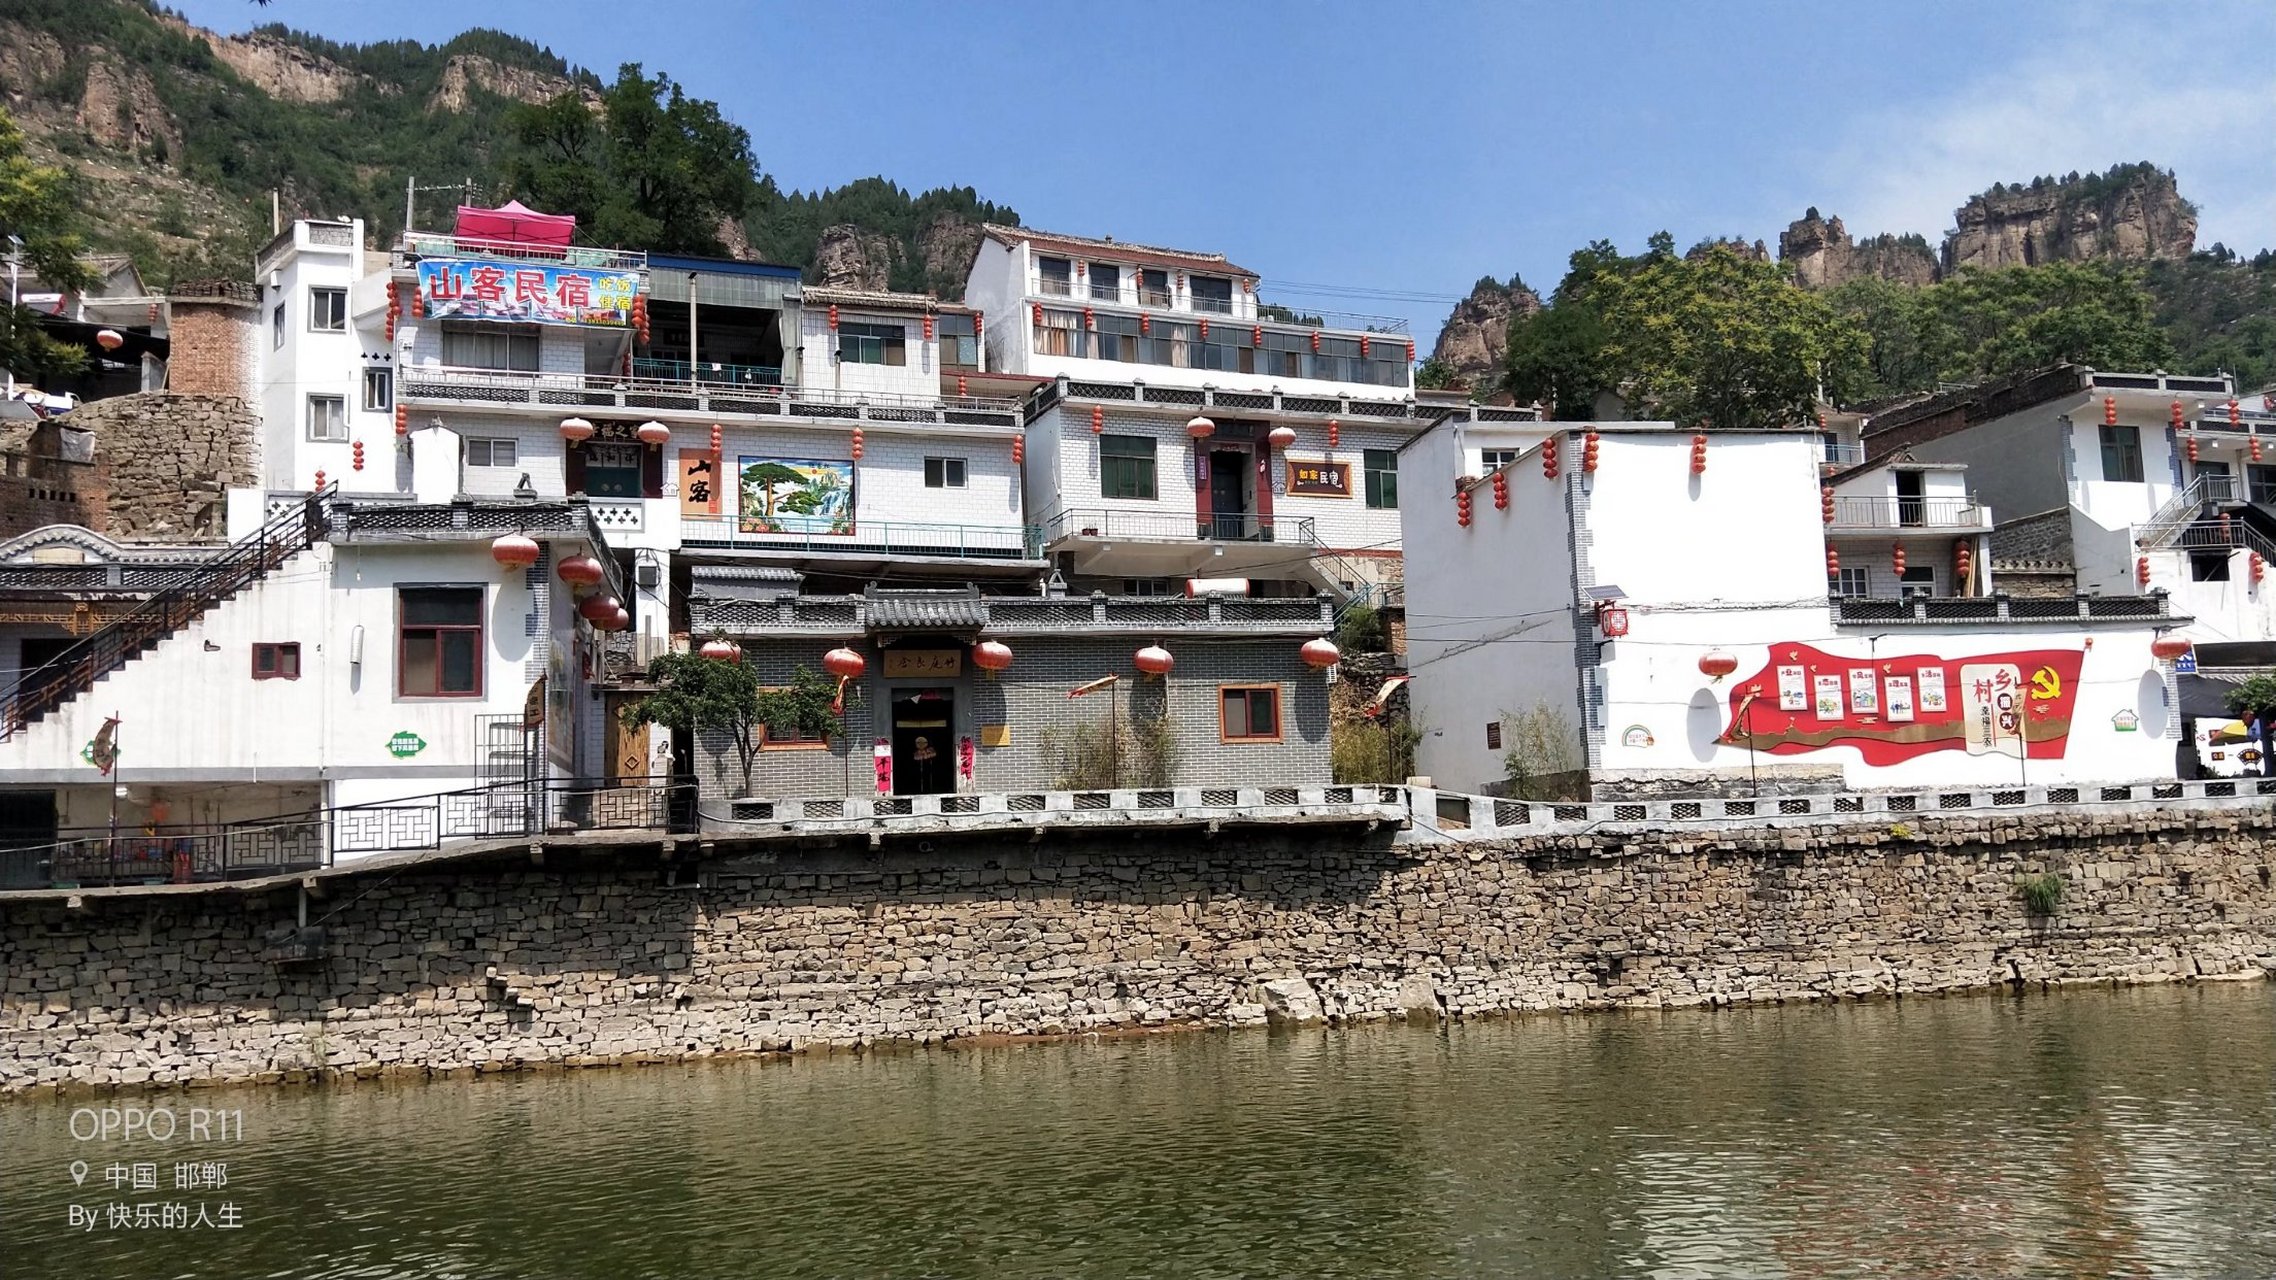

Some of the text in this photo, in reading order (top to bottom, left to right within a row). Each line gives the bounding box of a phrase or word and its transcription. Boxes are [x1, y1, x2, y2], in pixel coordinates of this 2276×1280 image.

[428, 266, 592, 309] 山客民宿
[598, 277, 632, 292] 吃饭
[599, 295, 632, 311] 住宿
[688, 459, 712, 503] 山客
